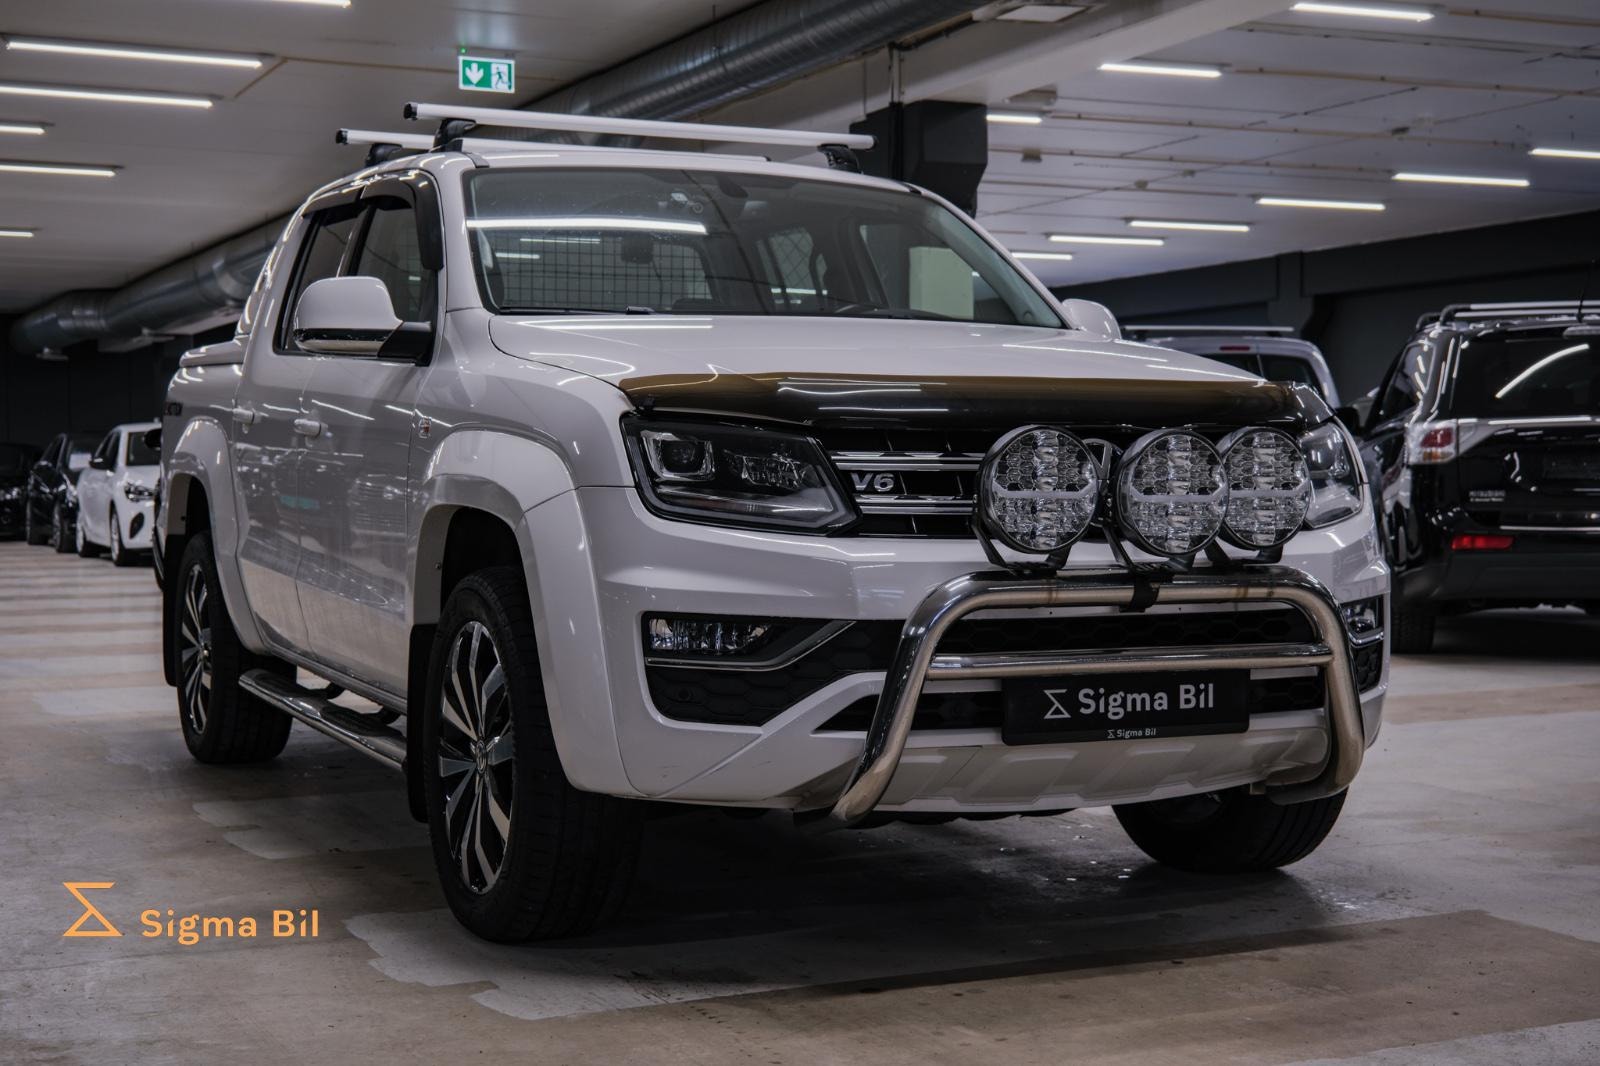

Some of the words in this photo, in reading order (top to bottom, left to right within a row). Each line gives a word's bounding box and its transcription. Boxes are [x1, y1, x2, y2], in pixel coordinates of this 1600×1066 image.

[850, 472, 895, 492] V6
[1078, 687, 1168, 720] Sigma
[1179, 683, 1214, 709] Bil
[1116, 729, 1143, 739] Sigma
[1145, 727, 1156, 736] Bil
